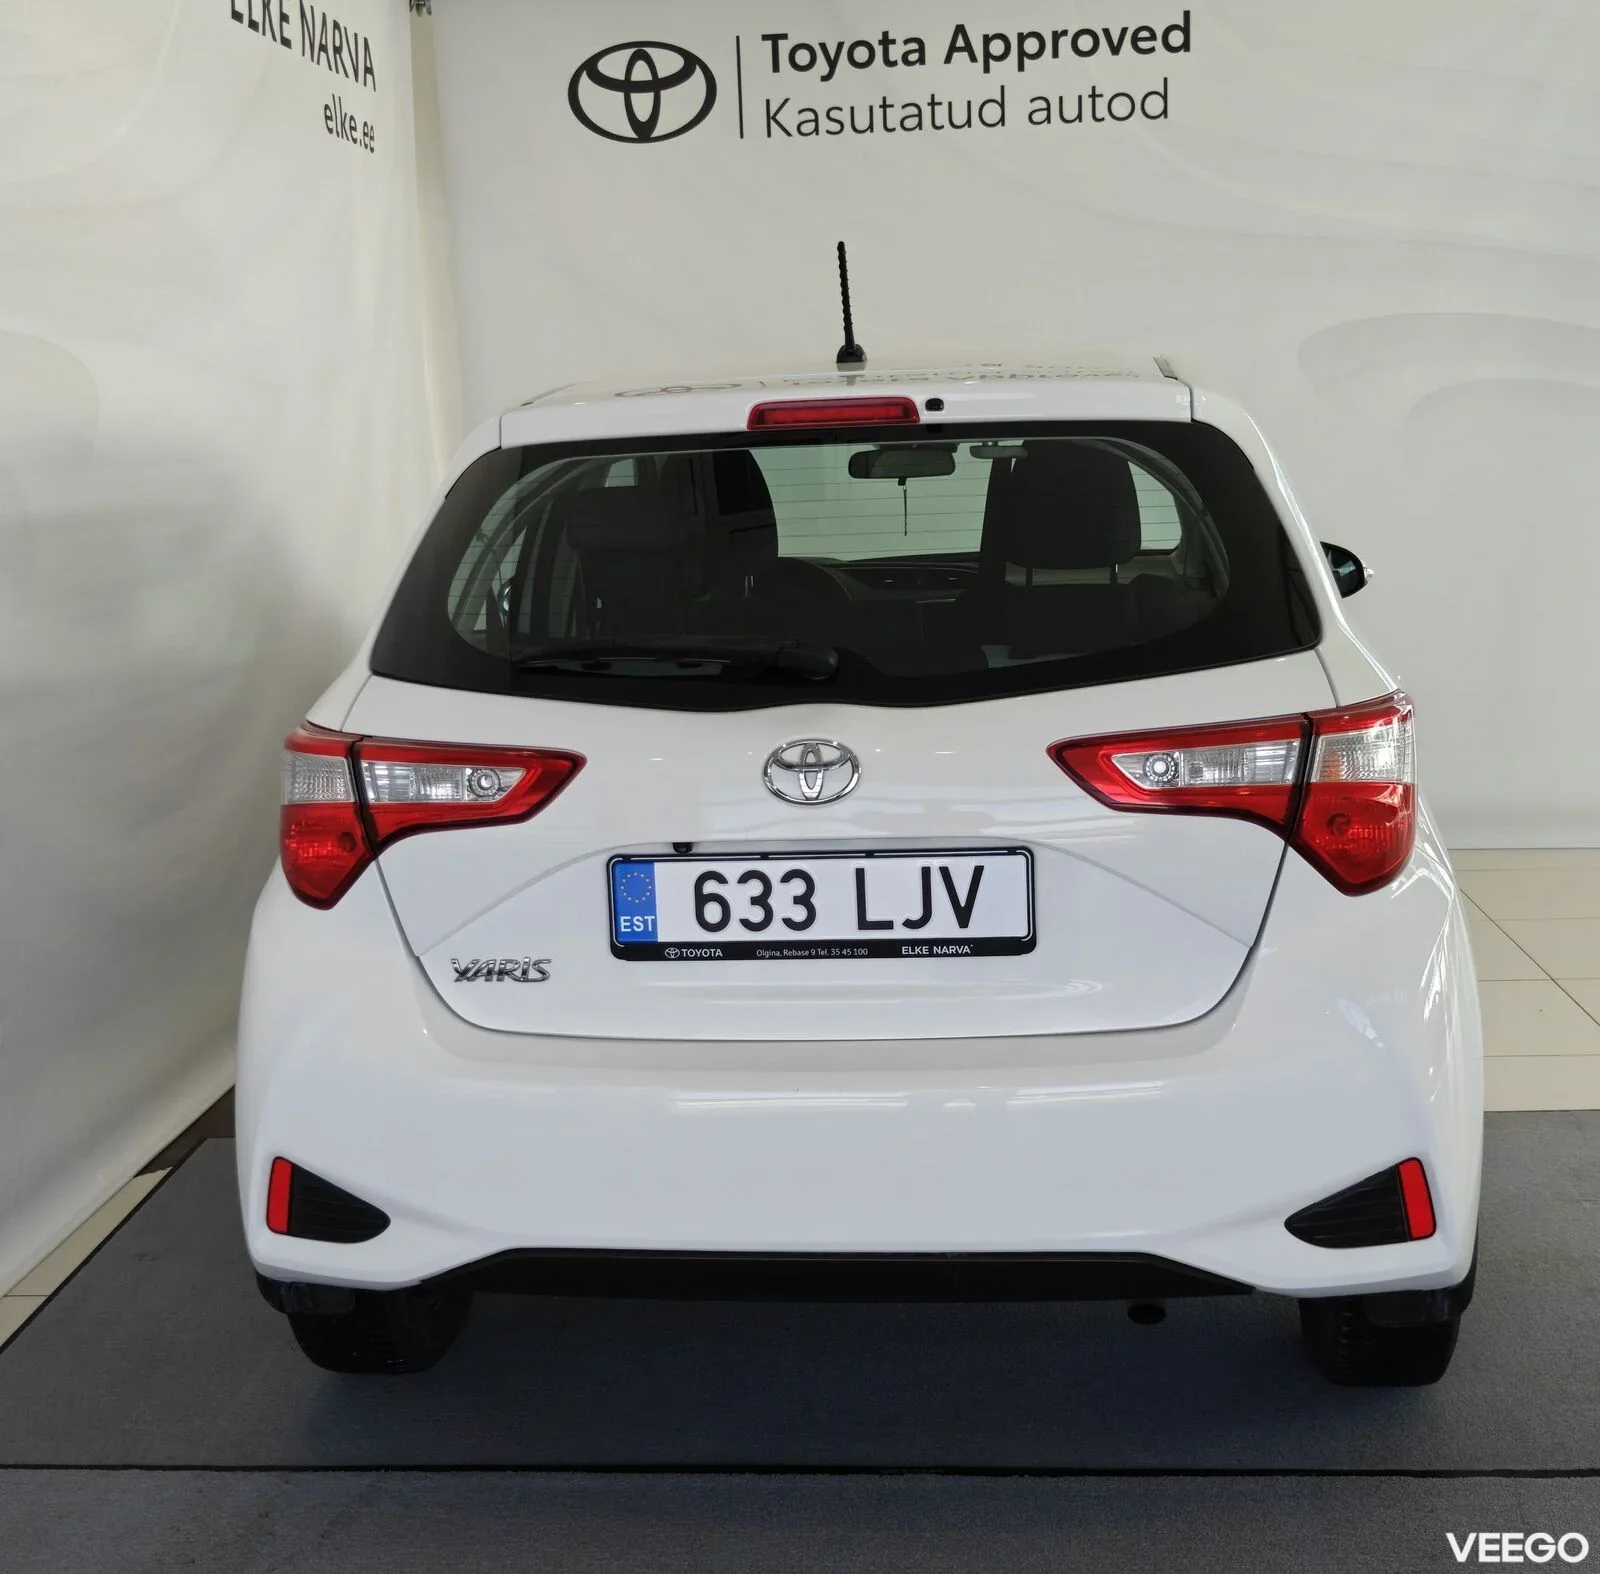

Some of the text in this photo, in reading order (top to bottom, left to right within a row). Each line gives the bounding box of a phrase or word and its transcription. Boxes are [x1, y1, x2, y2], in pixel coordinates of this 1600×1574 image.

[300, 0, 377, 93] NARVA
[762, 10, 1192, 82] Toyota Approved
[323, 93, 375, 154] elke.ee
[765, 77, 1170, 139] Kasutatud autod
[620, 915, 656, 932] EST
[693, 865, 985, 932] 633 LJV
[681, 948, 723, 958] TOYOTA
[756, 947, 868, 958] Olgina, Rebase 9 Tel. 35 45 100
[902, 946, 930, 955] ELKE
